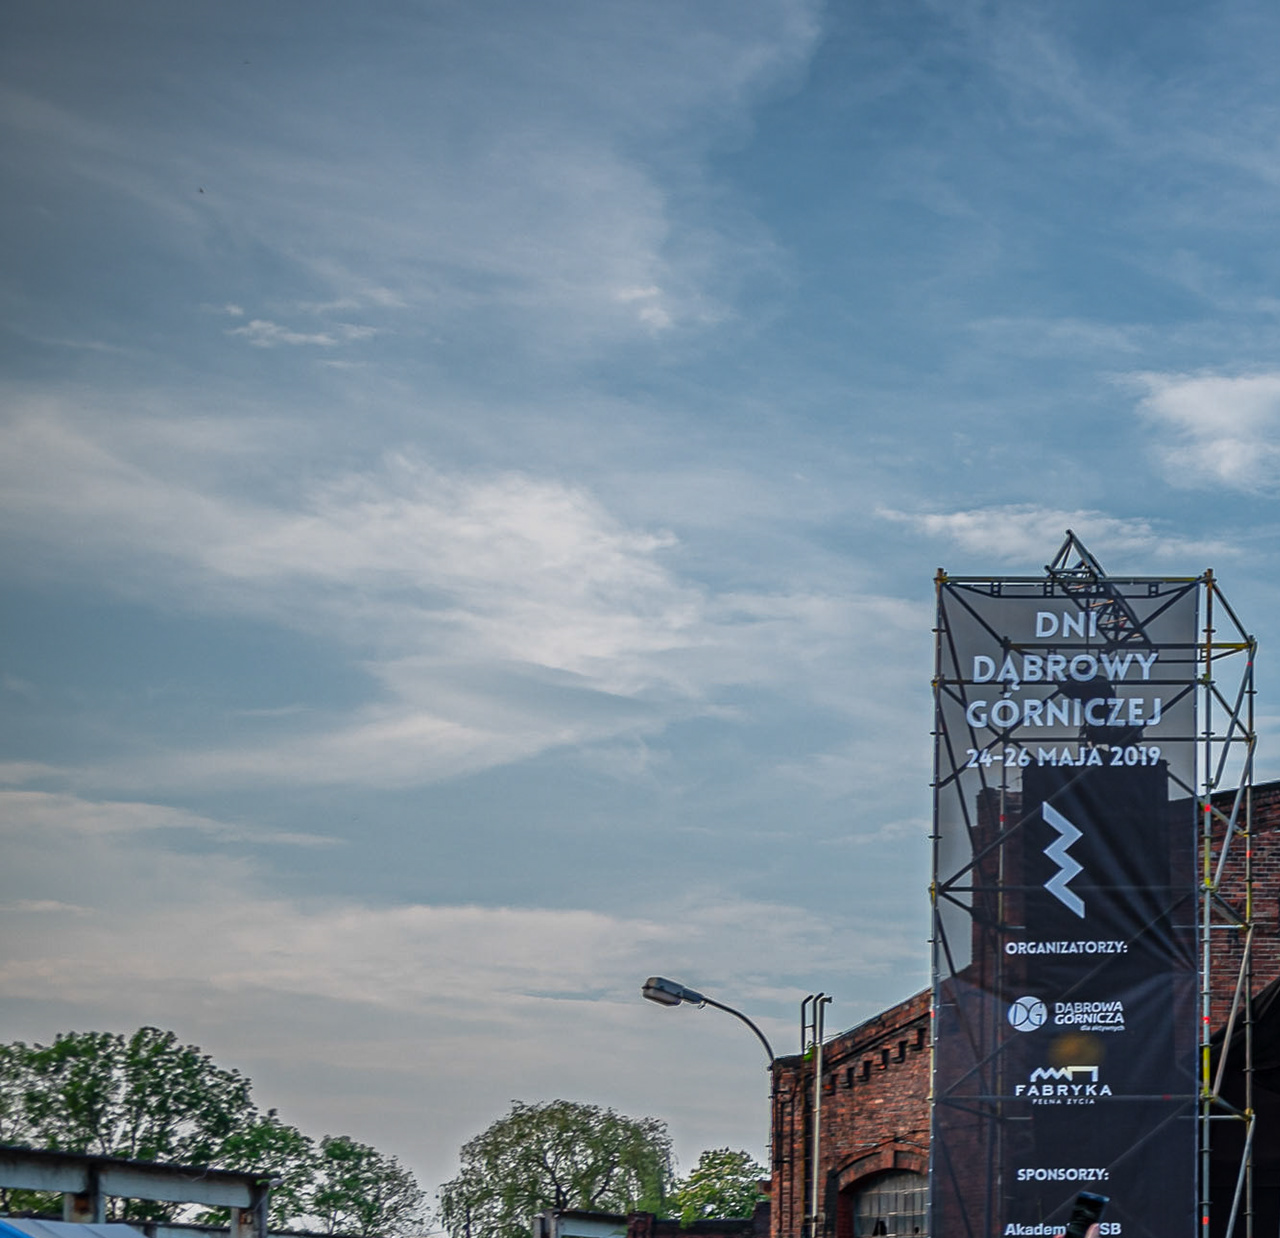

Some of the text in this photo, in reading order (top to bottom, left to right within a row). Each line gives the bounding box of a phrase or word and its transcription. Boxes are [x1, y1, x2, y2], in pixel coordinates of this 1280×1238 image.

[1035, 611, 1097, 638] DNI
[972, 653, 1159, 691] DĄBROWY
[965, 692, 1162, 729] GÓRNICZEJ
[966, 746, 1161, 768] 24-26 MAJA 2019
[1005, 941, 1128, 955] ORGANIZATORZY:
[1054, 1011, 1125, 1025] GÓRNICZA
[1015, 1084, 1113, 1096] FABRYKA
[1017, 1168, 1110, 1181] SPONSORZY:
